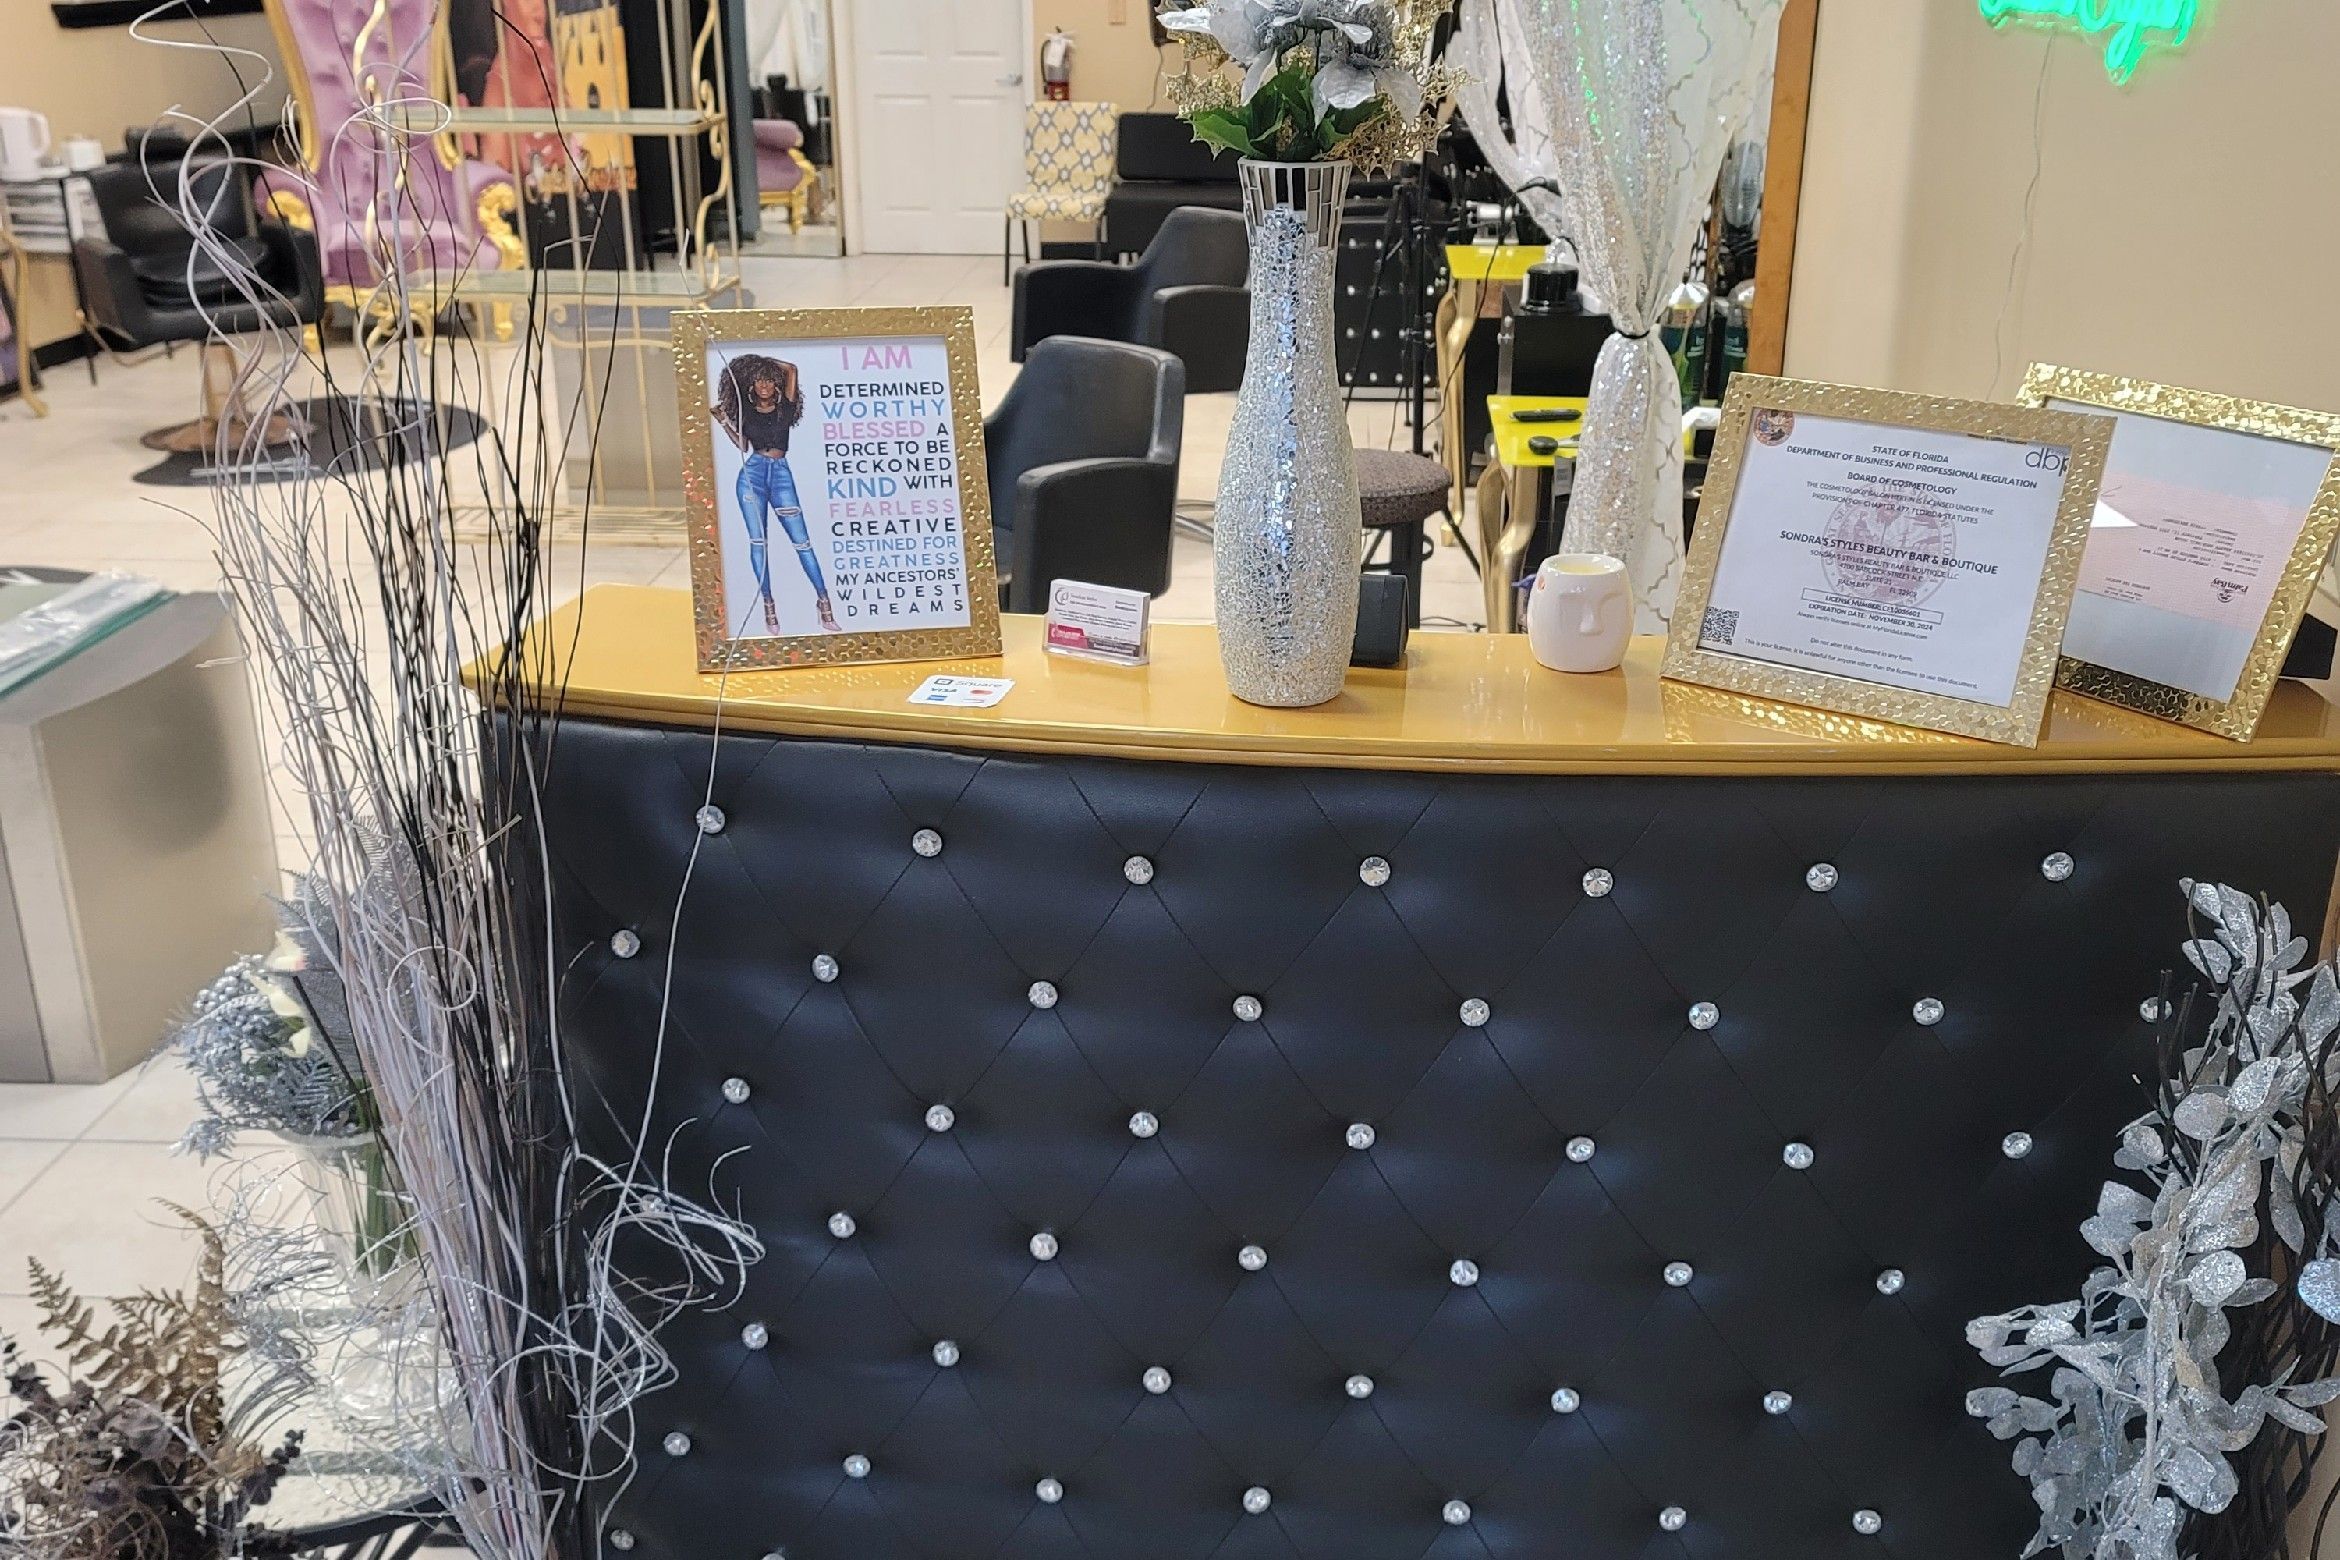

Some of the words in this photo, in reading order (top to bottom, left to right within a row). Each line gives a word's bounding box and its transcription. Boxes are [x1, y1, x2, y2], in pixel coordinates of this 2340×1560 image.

[841, 346, 849, 370] I
[861, 345, 912, 370] AM
[820, 381, 944, 398] DETERMINED
[821, 398, 945, 419] WORTHY
[823, 420, 925, 440] BLESSED
[937, 422, 949, 436] A
[825, 441, 888, 457] FORCE
[894, 440, 919, 455] TO
[927, 439, 950, 454] BE
[1872, 445, 1896, 456] STATE
[1898, 449, 1911, 458] OF
[1912, 451, 1948, 463] FLORIDA
[827, 458, 951, 475] RECKONED
[1786, 445, 1840, 460] DEPARTMENT
[1841, 453, 1853, 461] OF
[1855, 455, 1894, 468] BUSINESS
[1895, 459, 1915, 471] AND
[1916, 464, 1978, 480] PROFESSIONAL
[1980, 473, 2038, 488] REGULATION
[827, 476, 897, 499] KIND
[903, 474, 952, 489] WITH
[1847, 471, 1878, 484] BOARD
[1878, 476, 1892, 485] OF
[1892, 479, 1958, 495] COSMETOLOGY
[829, 498, 954, 518] FEARLESS
[1956, 502, 1979, 513] UNDER
[1981, 508, 1994, 516] THE
[831, 517, 956, 536] CREATIVE
[832, 537, 917, 554] DESTINED
[923, 535, 956, 549] FOR
[1780, 530, 1828, 547] SONDRA'S
[1830, 539, 1865, 552] STYLES
[1866, 544, 1908, 559] BEAUTY
[1908, 551, 1930, 563] BAR
[1932, 555, 1939, 565] &
[1942, 558, 1999, 575] BOUTIQUE
[834, 552, 959, 570] GREATNESS
[835, 573, 859, 586] MY
[864, 567, 960, 585] ANCESTORS'
[836, 583, 961, 601] WILDEST
[848, 599, 963, 617] DREAMS
